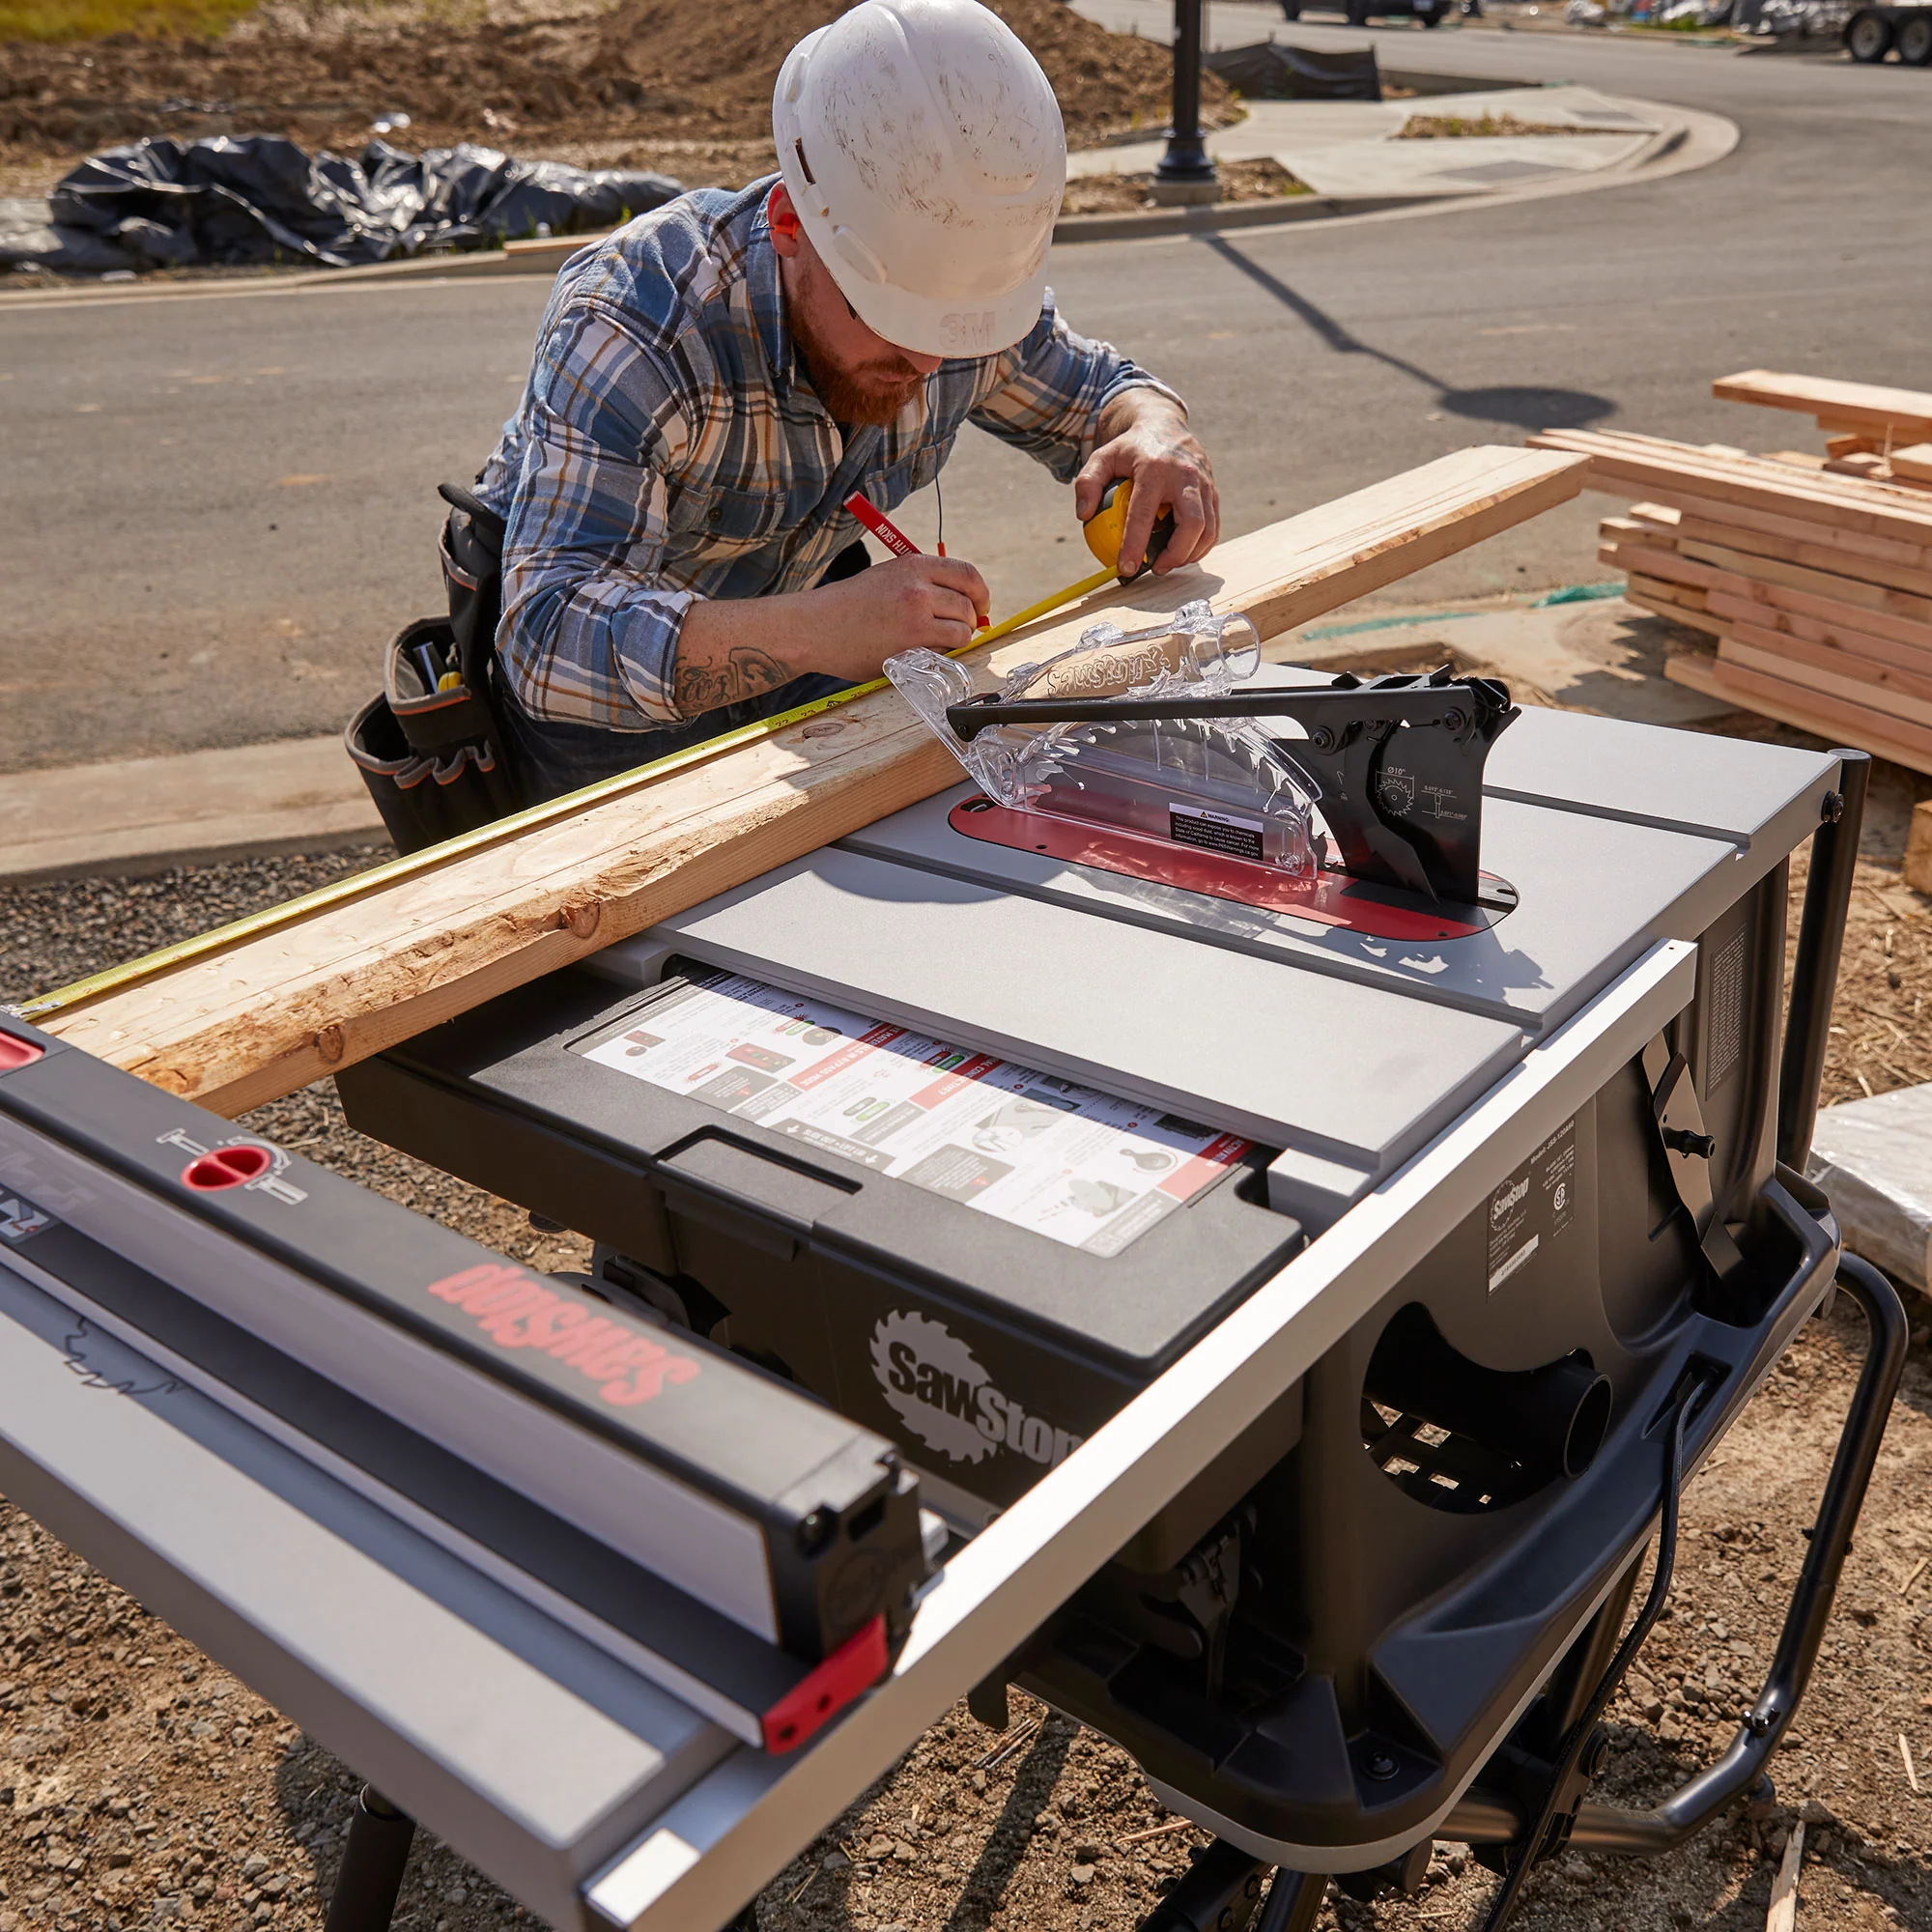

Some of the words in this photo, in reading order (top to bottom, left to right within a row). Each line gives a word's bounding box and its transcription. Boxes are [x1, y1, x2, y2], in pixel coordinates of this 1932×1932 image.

[938, 312, 996, 350] 3M
[874, 523, 897, 544] SKIN
[1175, 821, 1191, 830] including
[1493, 1177, 1529, 1220] SawStop
[427, 1263, 701, 1406] SawStop
